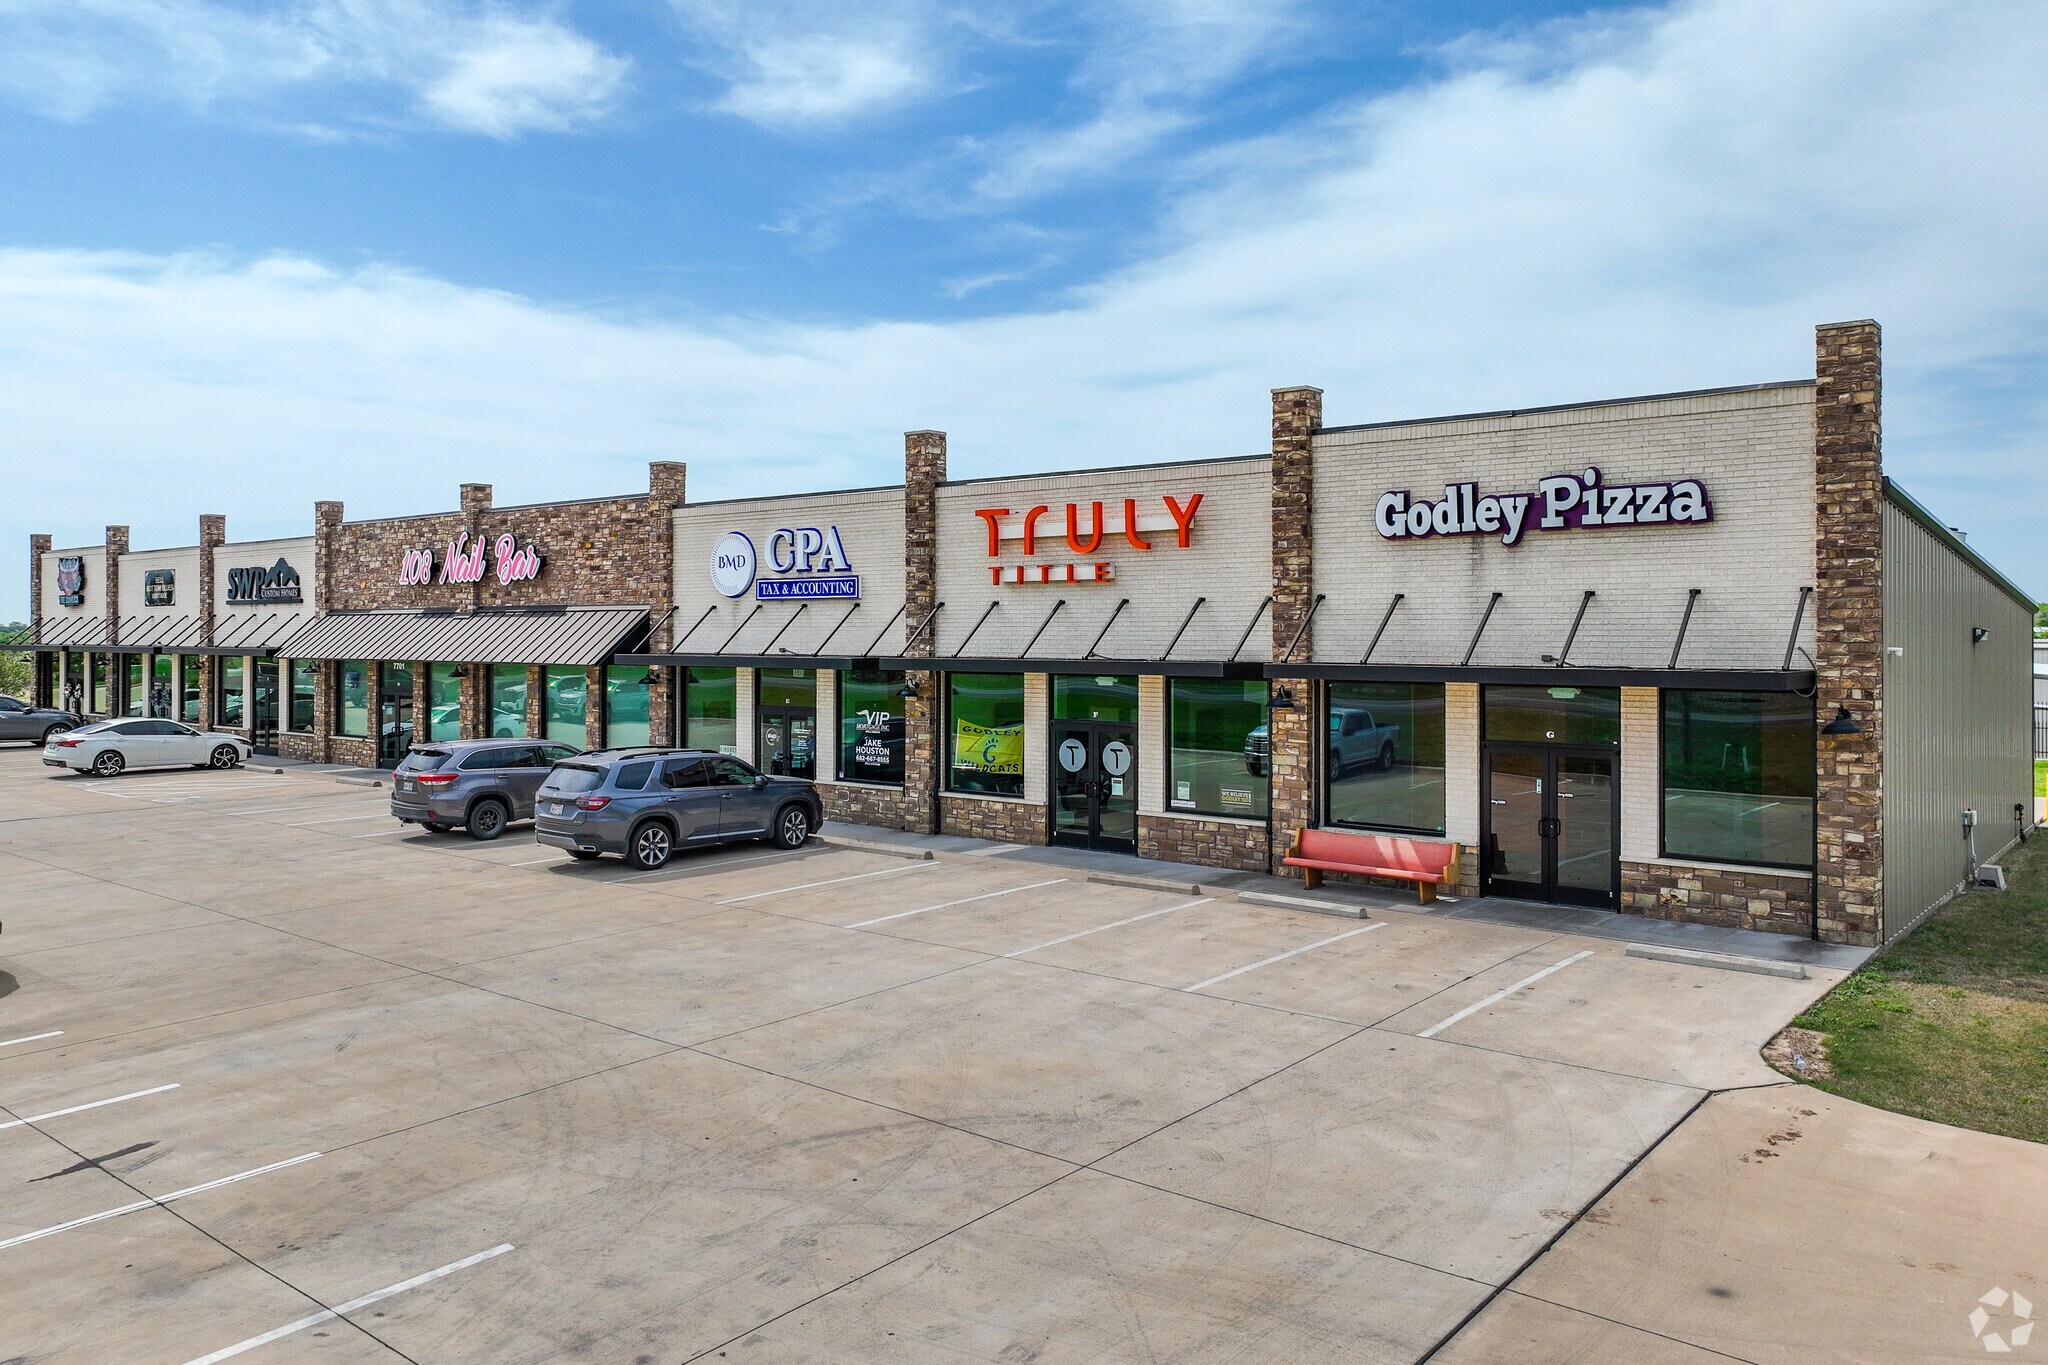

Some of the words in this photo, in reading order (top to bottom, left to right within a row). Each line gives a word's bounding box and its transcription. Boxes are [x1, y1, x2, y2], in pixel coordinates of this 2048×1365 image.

[1375, 483, 1530, 545] Godley
[1539, 467, 1712, 529] Pizza
[764, 525, 852, 574] CPA
[399, 549, 433, 585] 108
[439, 531, 486, 585] Nail
[495, 533, 540, 585] Bar
[717, 554, 746, 571] BMD
[154, 576, 165, 584] BELL
[988, 562, 1111, 585] TITLE
[227, 566, 268, 599] SWP
[760, 583, 780, 595] TAX
[781, 583, 789, 595] &
[791, 580, 854, 595] ACCOUNTING
[261, 589, 280, 598] CUSTOM
[281, 588, 298, 597] HOMES
[393, 662, 405, 670] 7701
[856, 709, 890, 726] VIP
[962, 725, 1021, 736] GODLEY
[1545, 730, 1555, 739] G
[863, 739, 882, 747] JAKE
[856, 746, 890, 756] HOUSTON
